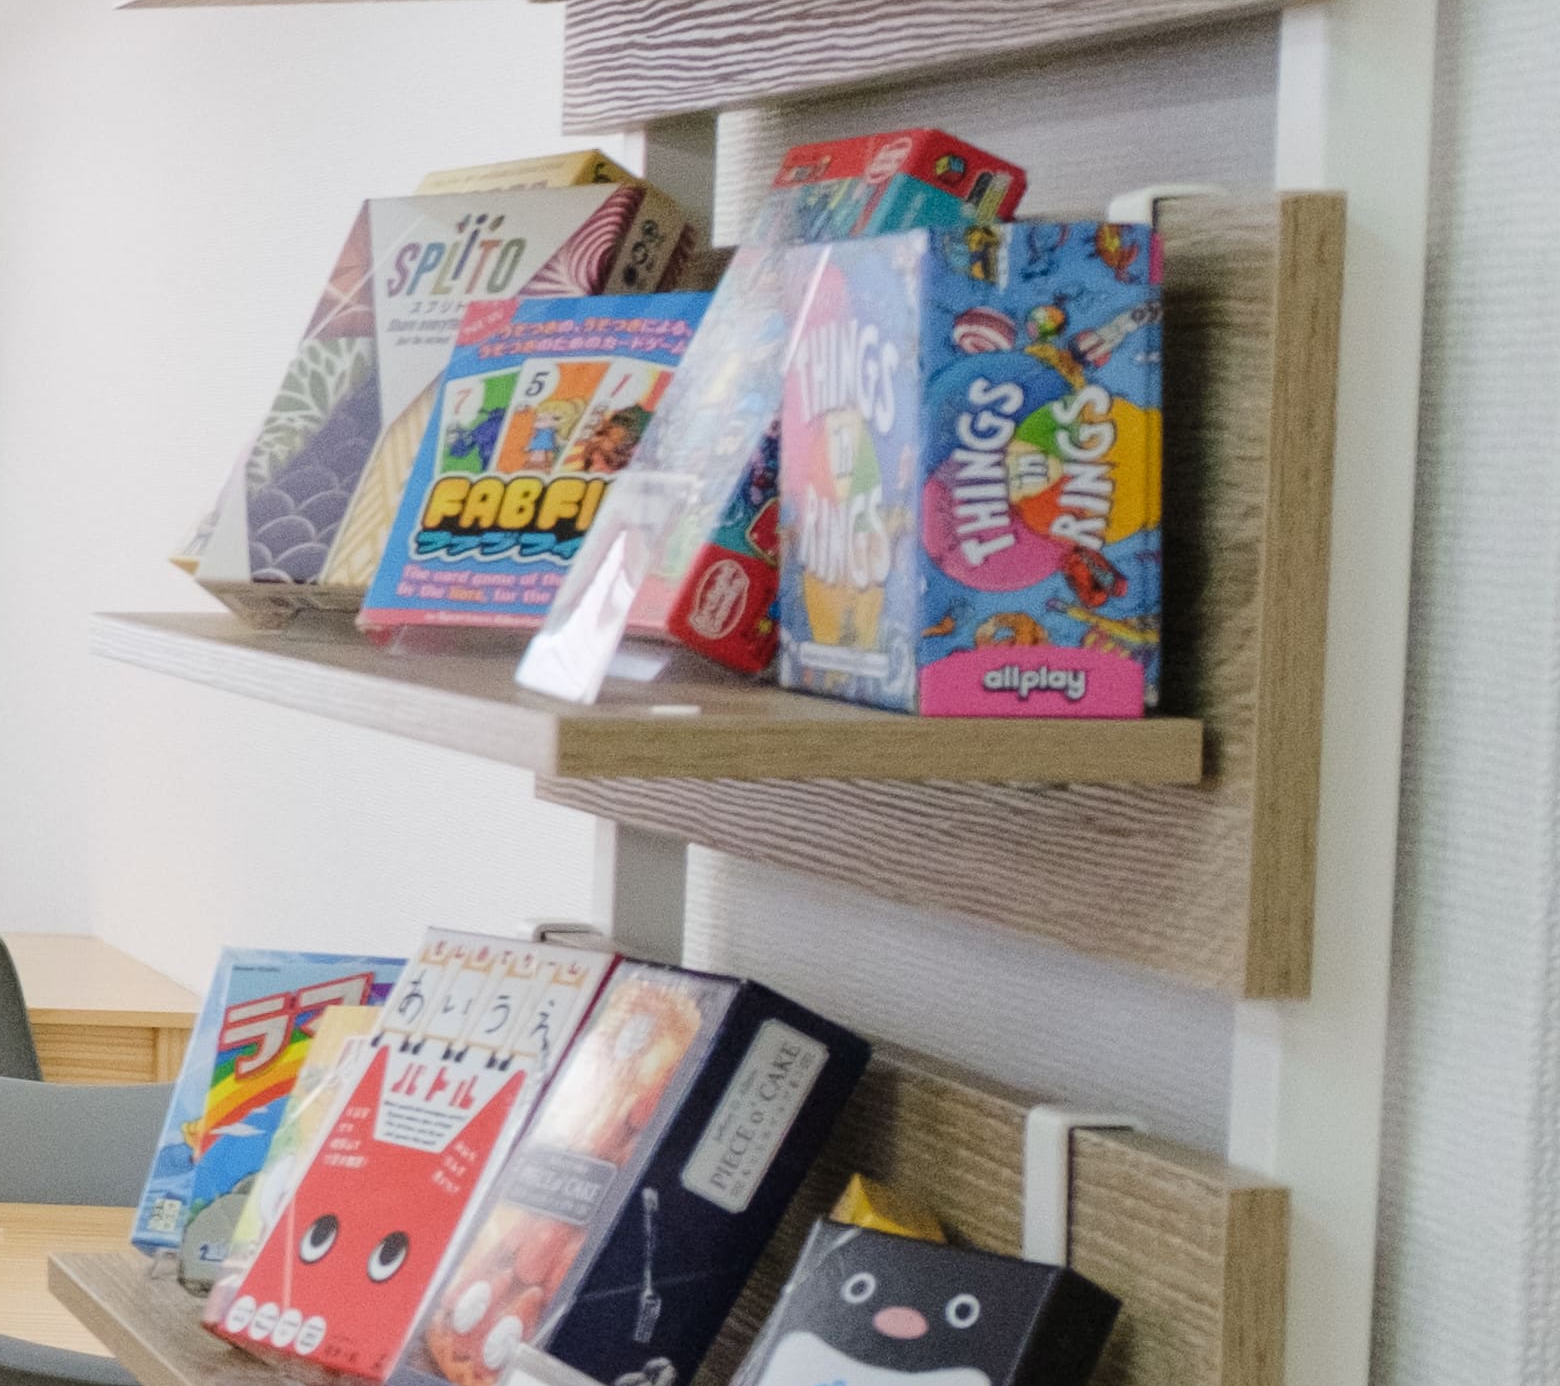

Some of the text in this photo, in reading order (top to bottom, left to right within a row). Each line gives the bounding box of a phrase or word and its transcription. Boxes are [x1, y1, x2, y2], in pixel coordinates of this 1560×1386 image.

[387, 218, 527, 298] SPLITO
[525, 371, 550, 398] 5
[952, 376, 1025, 566] THINGS
[1049, 383, 1116, 552] RINGS
[421, 475, 607, 531] FABFI
[416, 529, 585, 561] ファブフィ
[982, 665, 1087, 701] allplay
[709, 1125, 755, 1191] PIECE
[758, 1043, 801, 1101] CAKE
